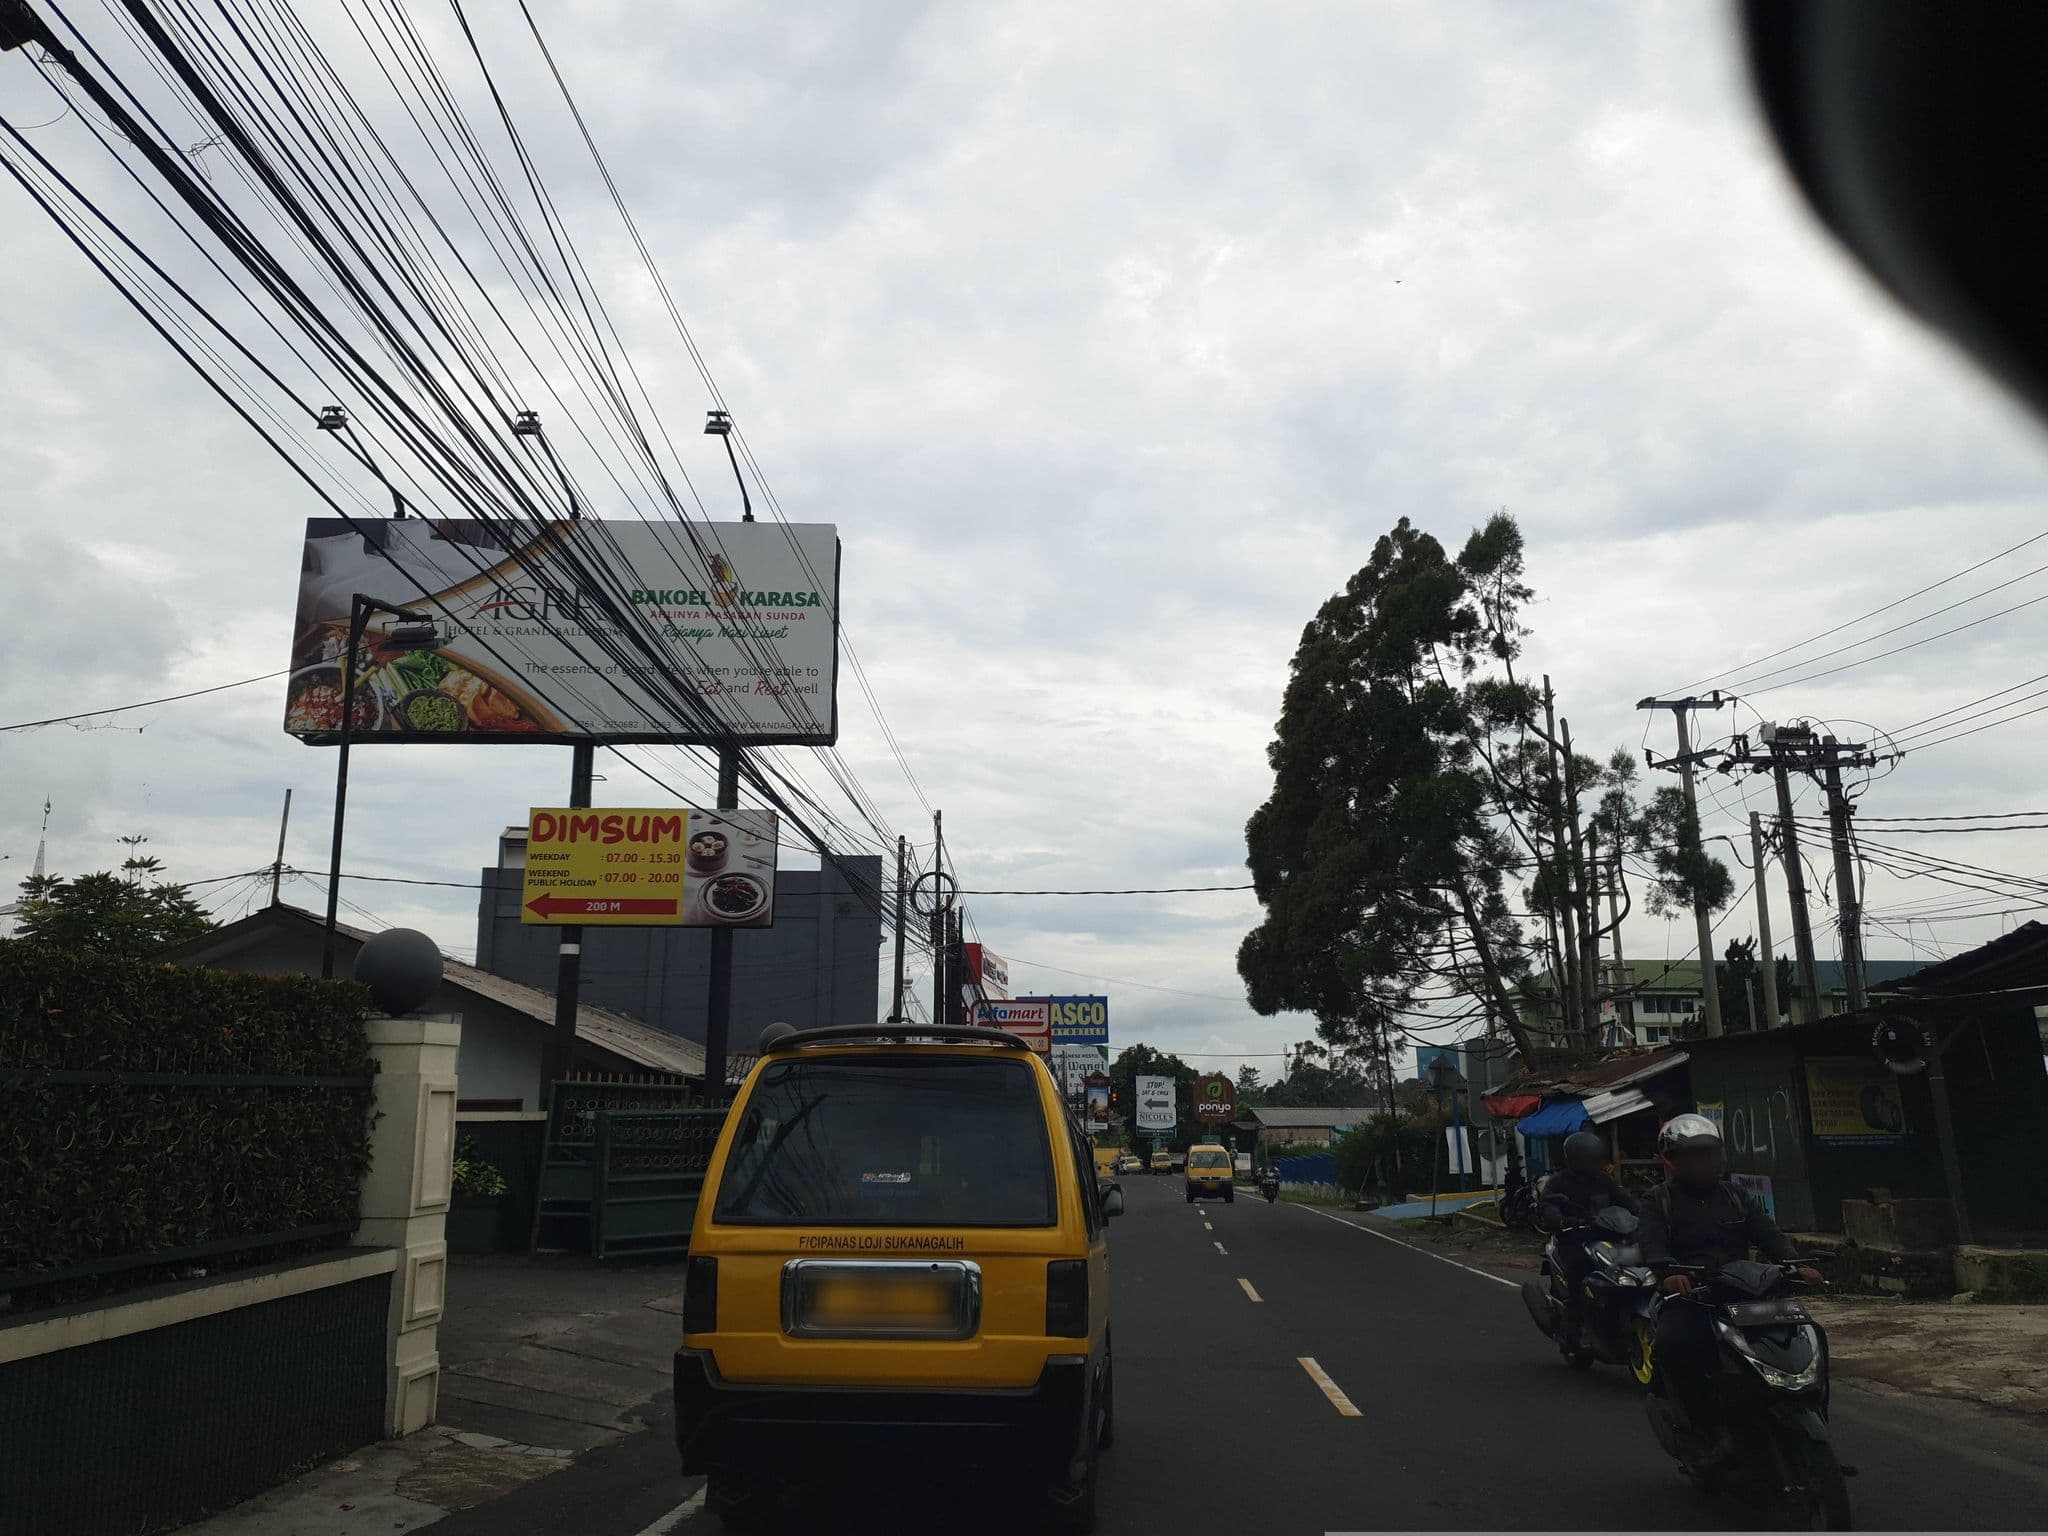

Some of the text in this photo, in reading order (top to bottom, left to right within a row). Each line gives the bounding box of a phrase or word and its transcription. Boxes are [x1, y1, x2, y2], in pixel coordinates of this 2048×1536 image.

[467, 586, 606, 621] AGRA
[632, 589, 820, 607] BAKOEL KARASA
[650, 610, 806, 621] AHLINYA MASAKAN SUNDA
[448, 626, 489, 636] HOTEL
[493, 627, 503, 636] &
[505, 627, 552, 637] GRAND
[525, 662, 547, 674] The
[551, 665, 601, 674] essence
[605, 662, 619, 674] of
[696, 665, 730, 675] when
[777, 665, 802, 676] able
[806, 666, 819, 676] to
[727, 683, 750, 693] and
[795, 682, 818, 693] well
[531, 812, 682, 844] DIMSUM
[530, 853, 571, 861] WEEKDAY
[606, 853, 638, 863] 07.00
[649, 853, 681, 864] 15.30
[528, 870, 570, 878] WEEKEND
[605, 873, 637, 883] 07.00
[648, 873, 680, 883] 20.00
[528, 878, 598, 887] PUBLIC HOLIDAY
[586, 901, 621, 912] 200 M
[1146, 1081, 1165, 1089] STOP!
[1198, 1103, 1232, 1113] ponyo
[798, 1235, 965, 1250] F/CIPANAS LOJI SUKANAGALIH
